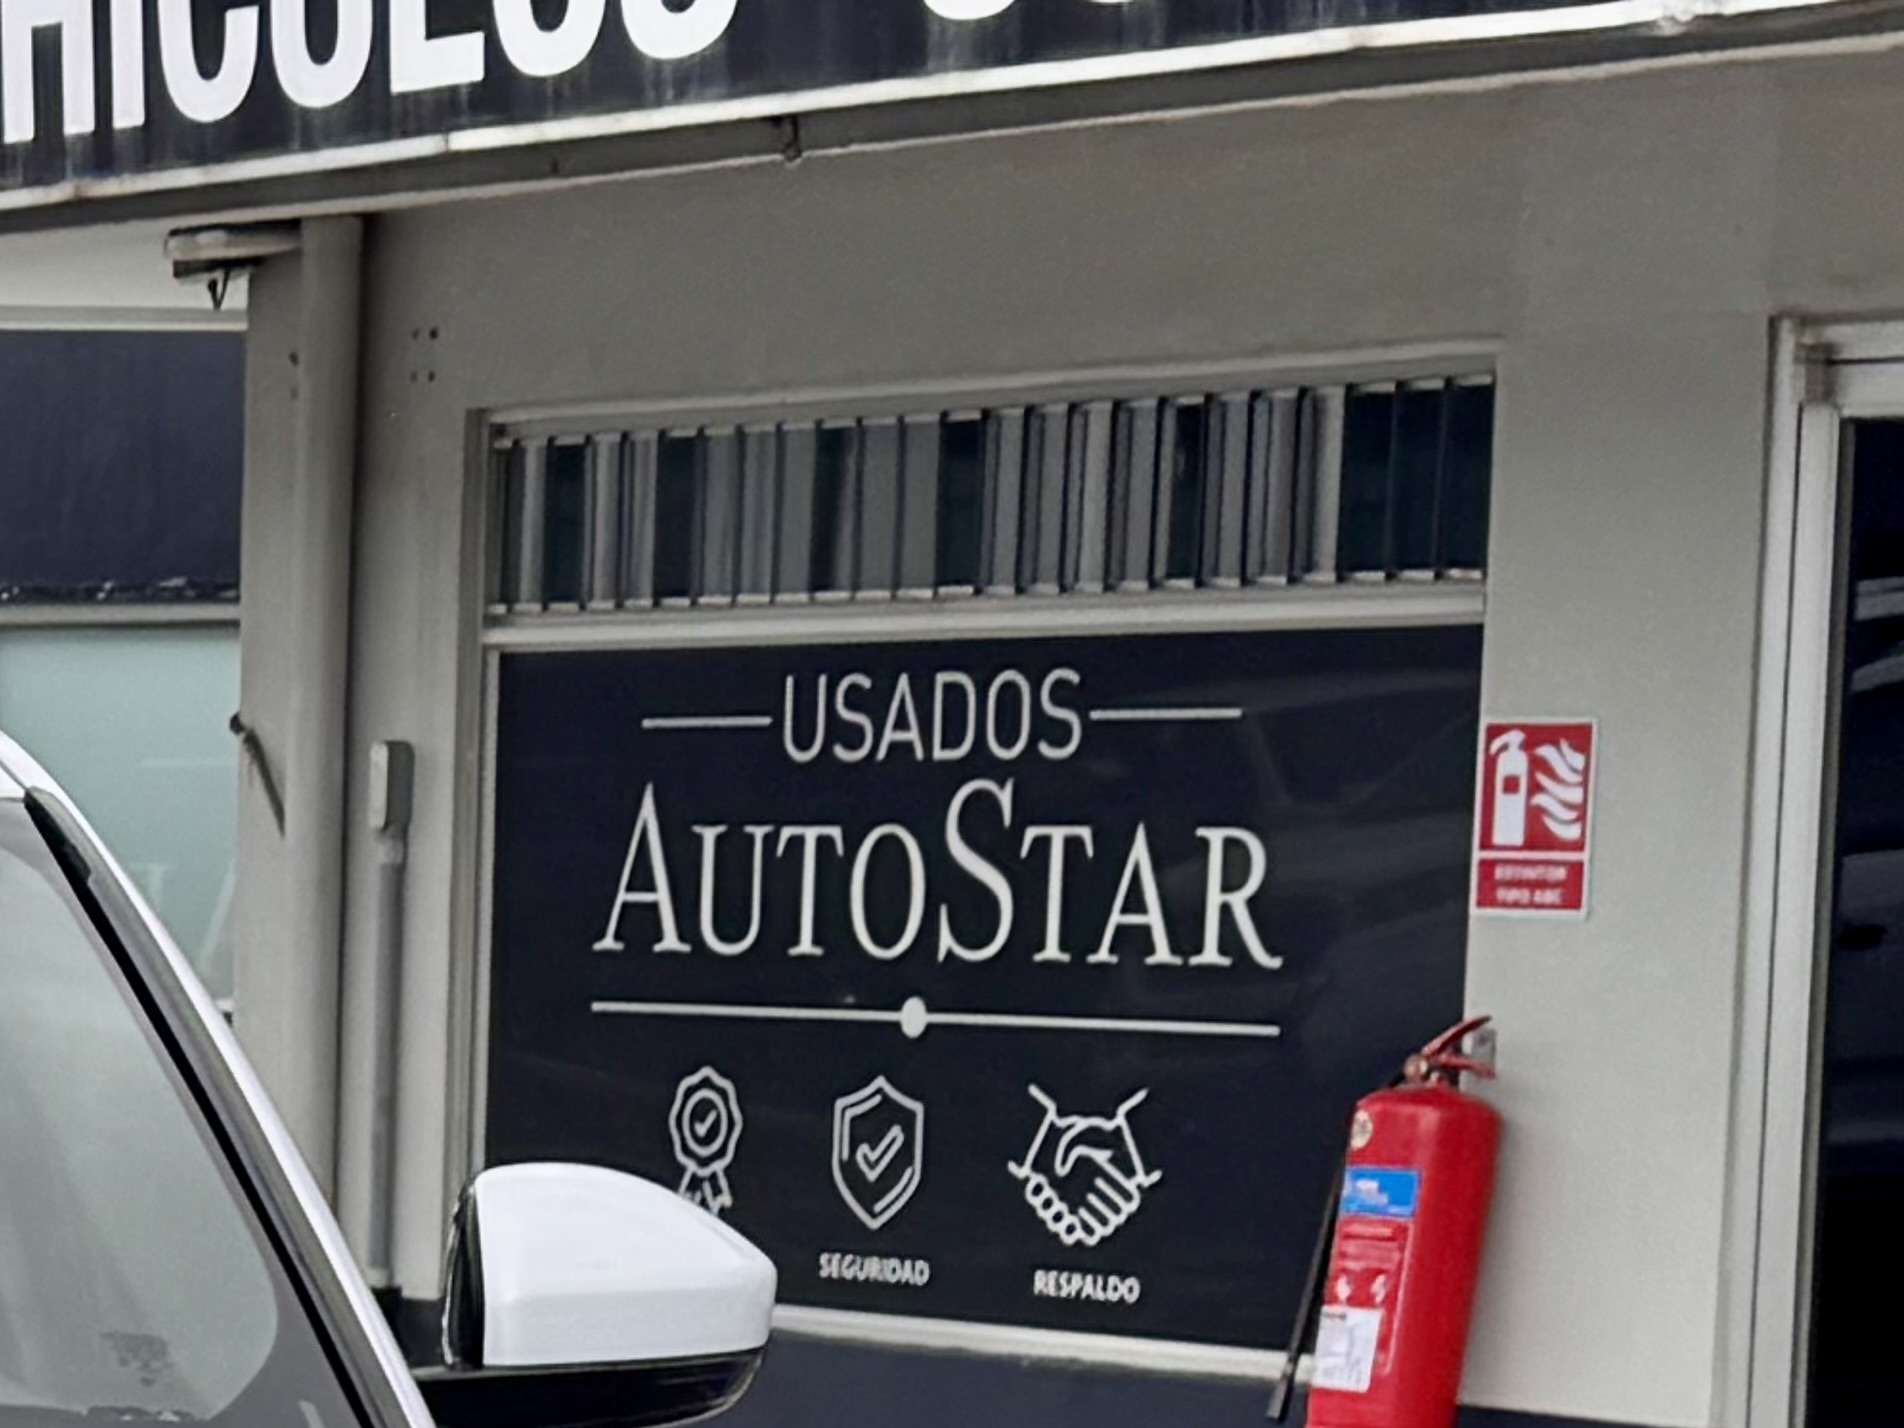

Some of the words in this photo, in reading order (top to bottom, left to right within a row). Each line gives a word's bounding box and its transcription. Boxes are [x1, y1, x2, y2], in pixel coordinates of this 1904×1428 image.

[783, 668, 1082, 763] USADOS
[819, 1251, 931, 1287] SEGURIDAD
[1033, 1268, 1142, 1305] RESPALDO
